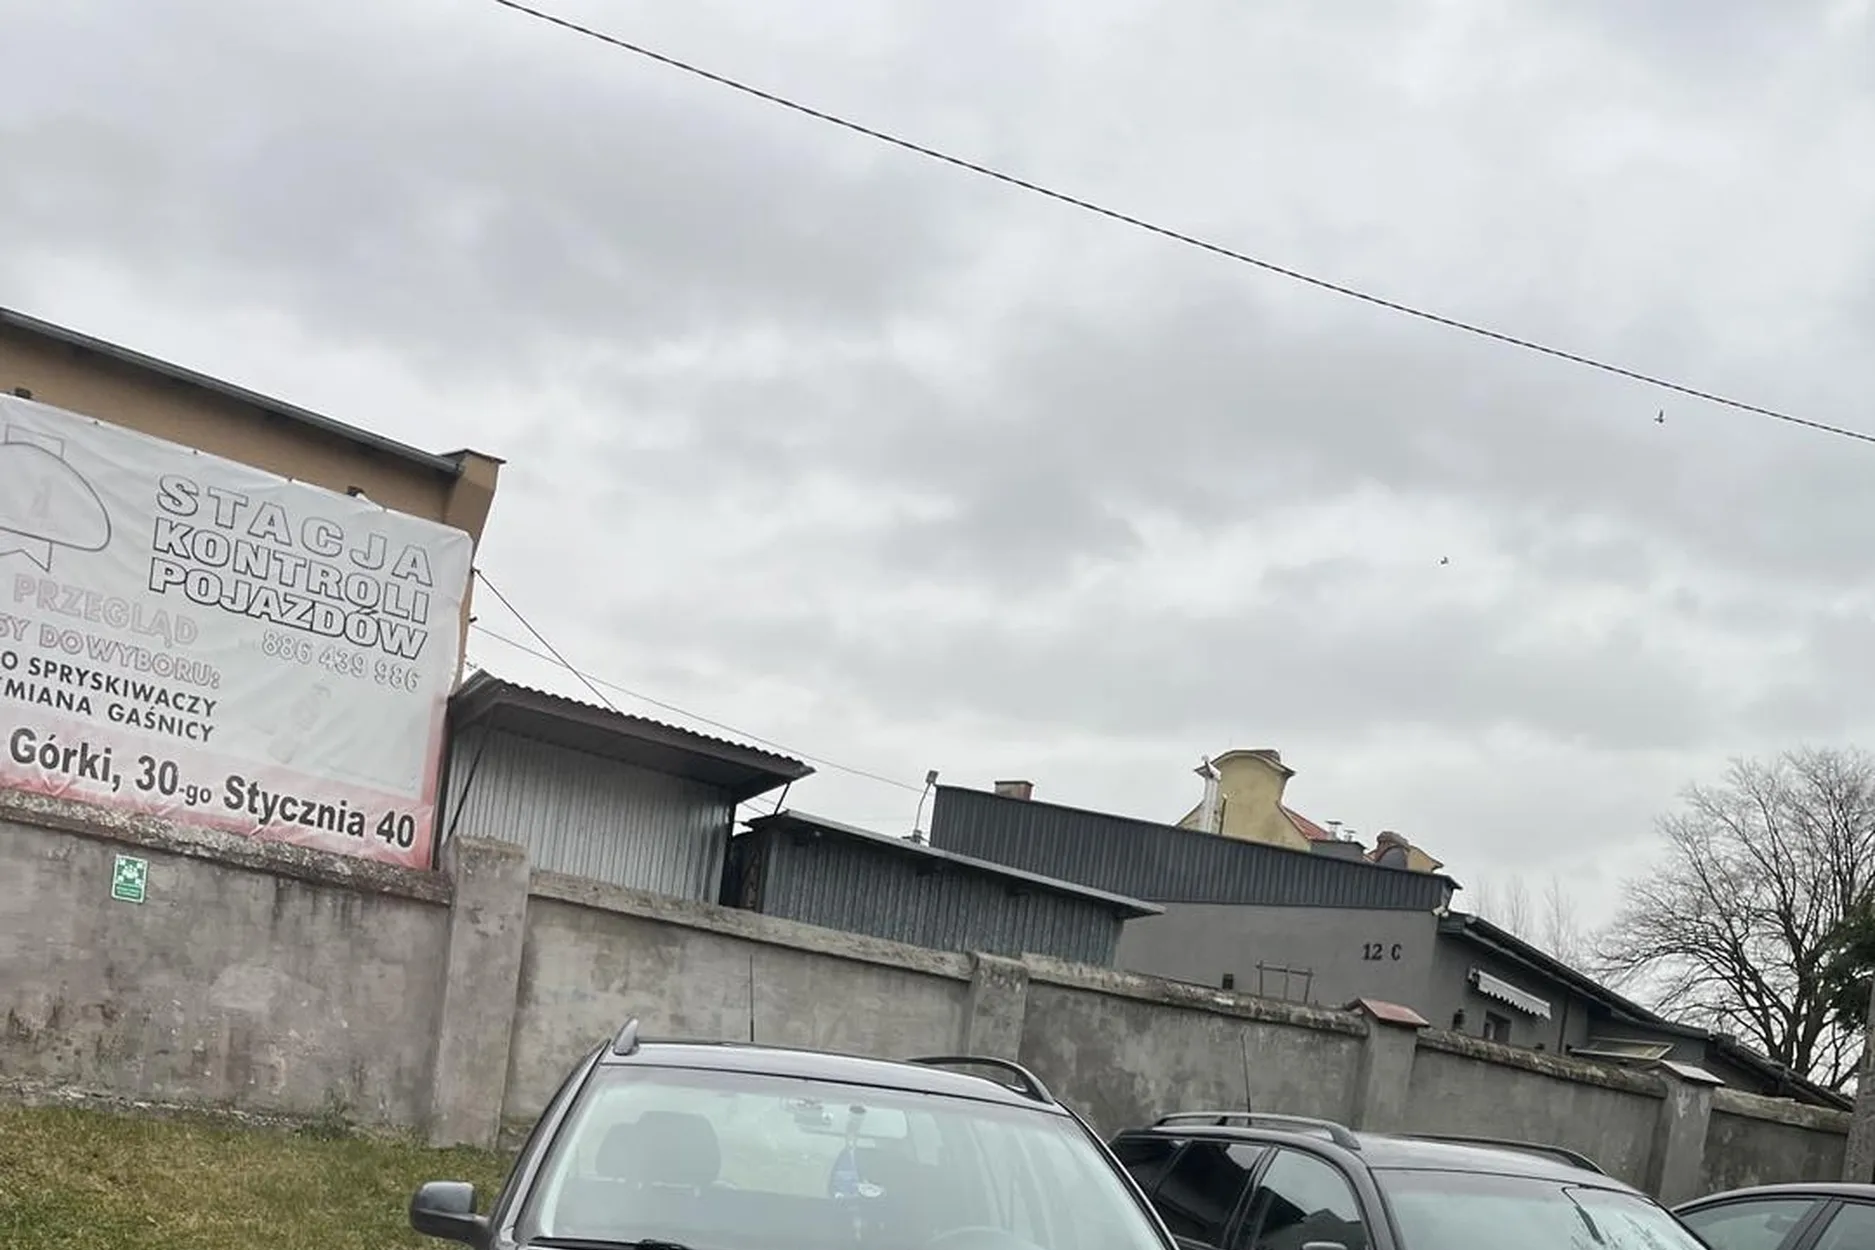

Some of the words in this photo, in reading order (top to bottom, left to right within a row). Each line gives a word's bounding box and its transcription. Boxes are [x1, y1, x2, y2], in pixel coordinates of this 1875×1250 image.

[152, 517, 430, 624] KONTROLI
[157, 474, 433, 587] STACJA
[149, 557, 428, 660] POJAZDÓW
[0, 676, 92, 715] MIANA
[107, 706, 214, 742] GAŚNICY
[28, 657, 217, 717] SPRYSKIWACZY
[10, 728, 121, 792] Górki,
[135, 754, 212, 805] 30-go
[223, 775, 366, 838] Stycznia
[376, 810, 416, 849] 40
[1363, 943, 1382, 961] 12
